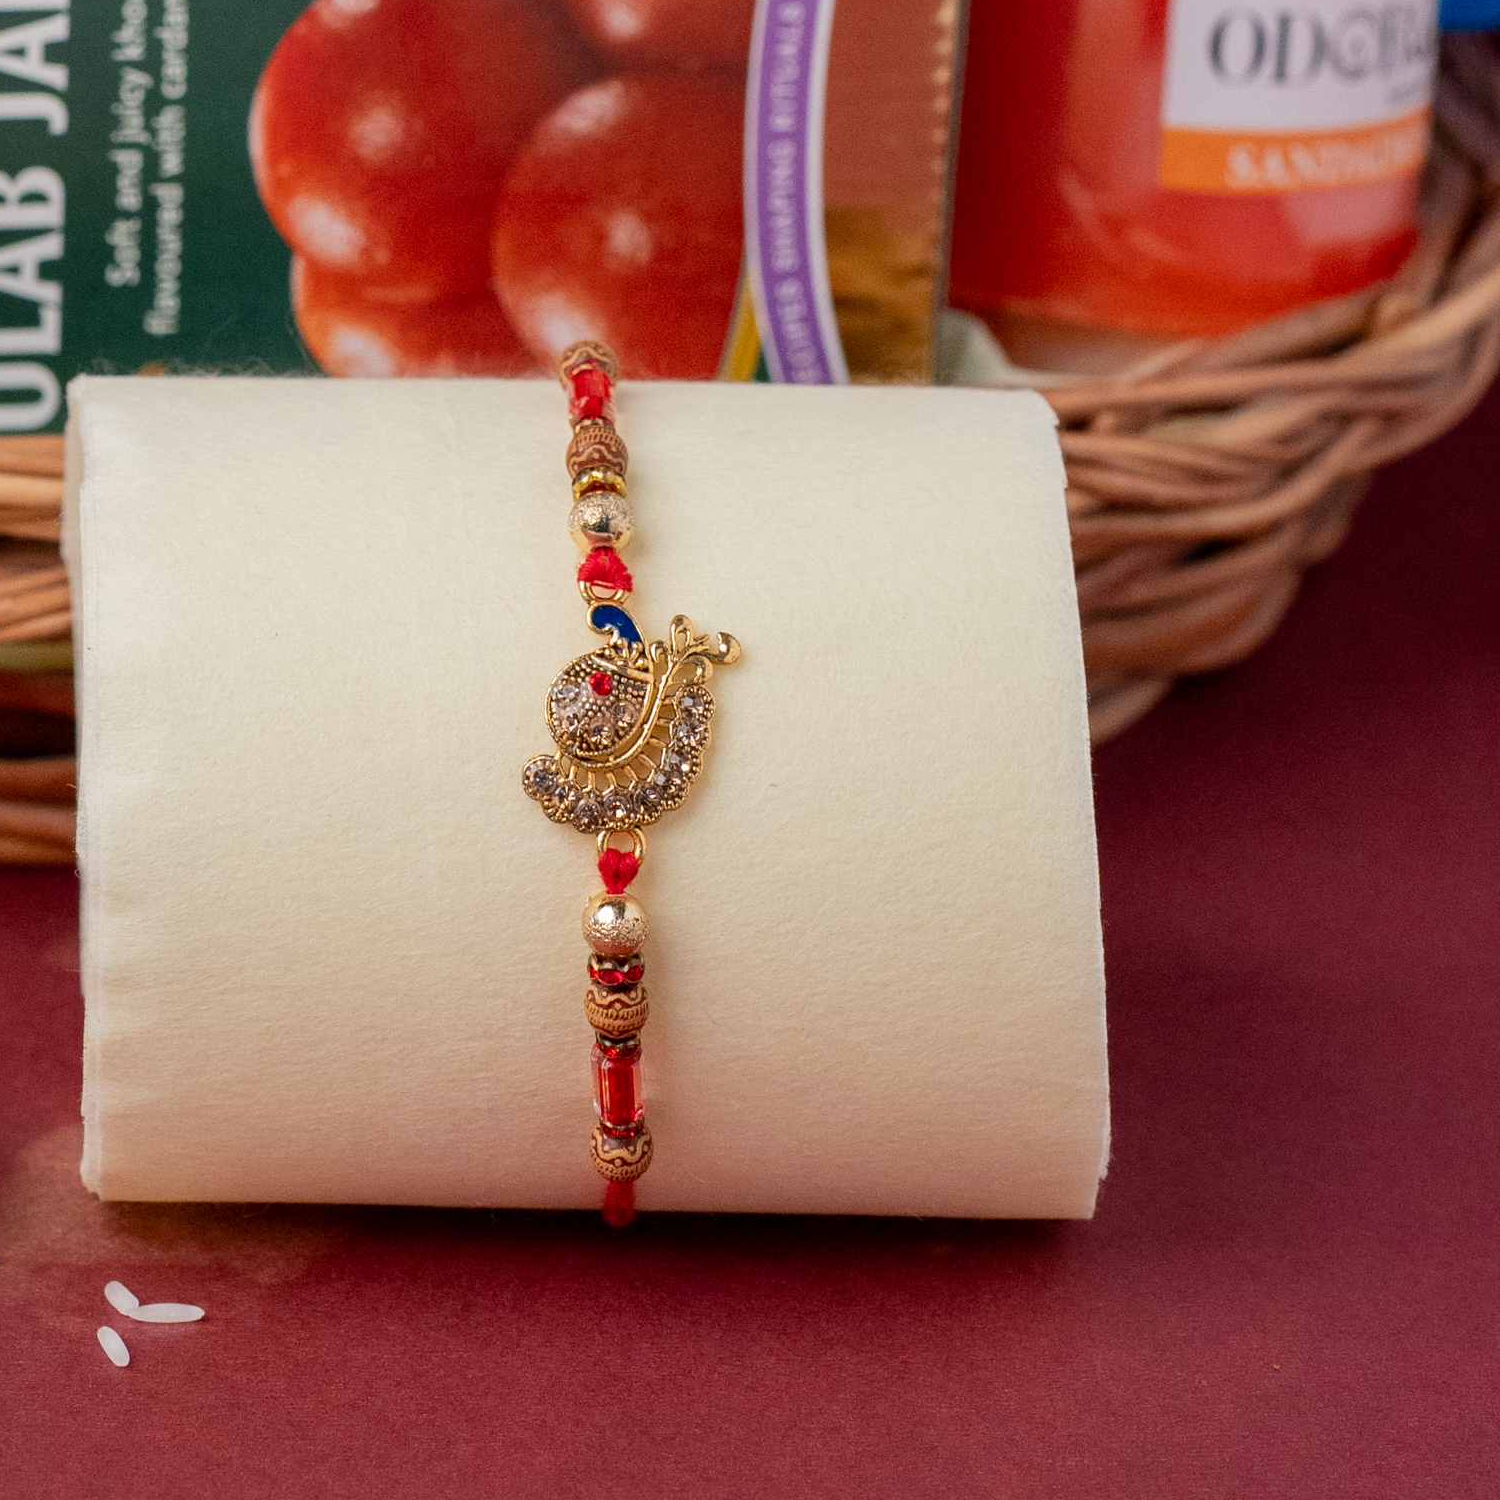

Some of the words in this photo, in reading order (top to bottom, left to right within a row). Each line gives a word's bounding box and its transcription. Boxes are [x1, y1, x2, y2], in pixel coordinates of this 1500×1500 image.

[109, 65, 155, 145] juicy
[151, 104, 187, 178] with
[107, 148, 144, 212] and
[104, 216, 142, 288] Soft
[143, 182, 185, 336] flavoured
